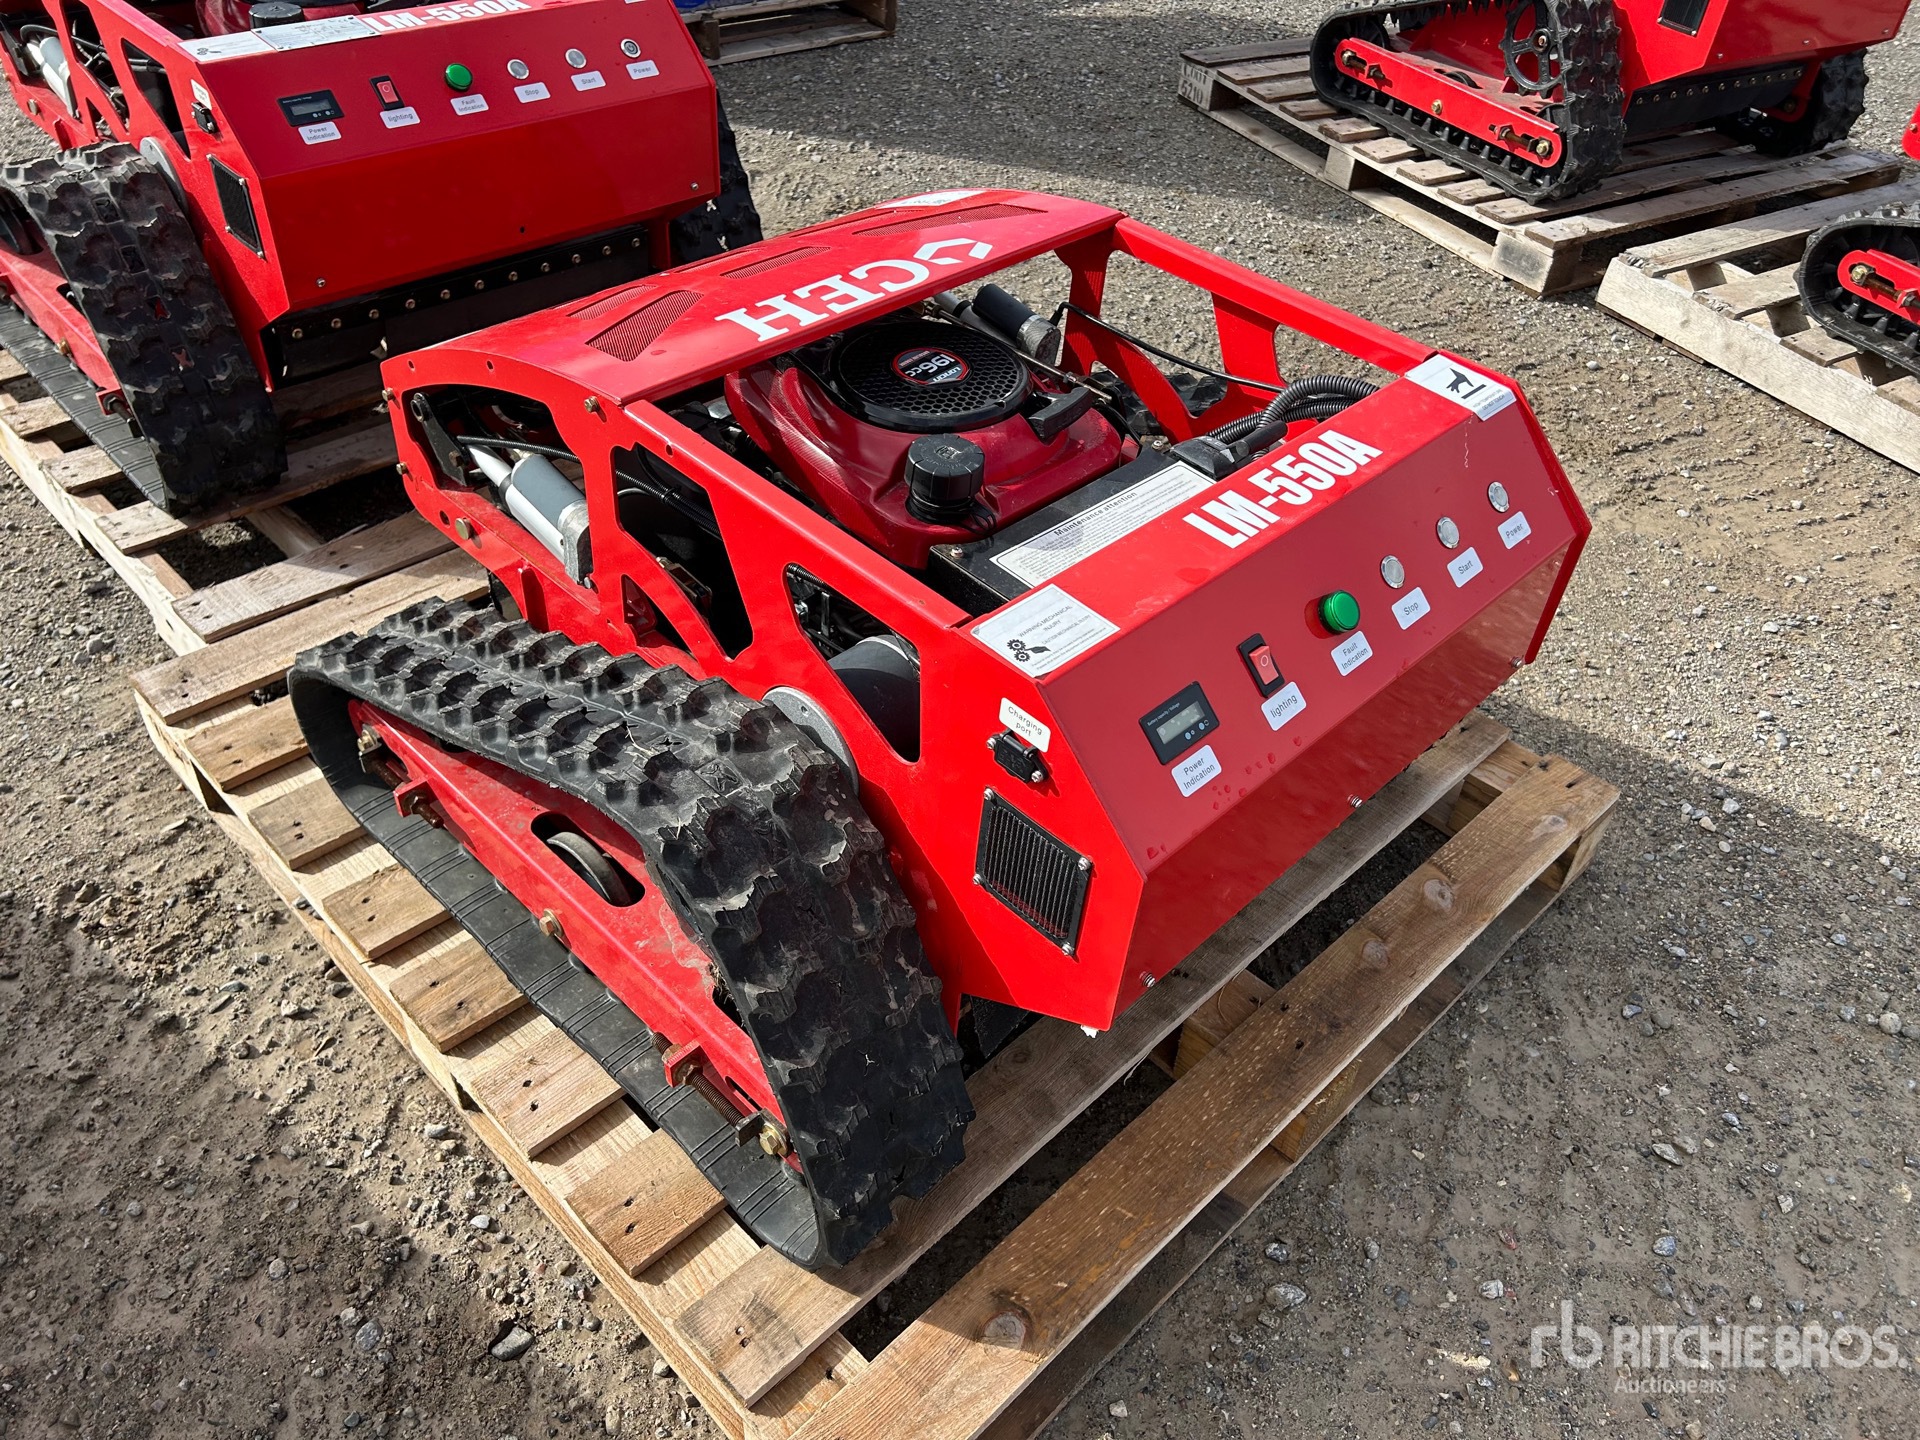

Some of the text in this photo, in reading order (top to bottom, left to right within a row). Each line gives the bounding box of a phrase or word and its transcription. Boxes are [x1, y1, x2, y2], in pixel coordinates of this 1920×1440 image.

[363, 0, 531, 31] LM-550A
[581, 76, 596, 85] Start
[524, 89, 540, 97] Stop
[388, 112, 413, 123] lighting
[905, 354, 956, 377] 196cc
[1181, 429, 1384, 549] LM-550A
[1053, 491, 1138, 537] Maintenance attention
[1505, 523, 1523, 539] Power
[1457, 560, 1473, 575] Start
[1403, 601, 1419, 616] Stop
[1342, 642, 1358, 656] Fault
[1341, 648, 1369, 670] Indication
[1270, 694, 1298, 718] lighting
[1008, 706, 1043, 736] Charging
[1015, 722, 1032, 736] port
[1183, 757, 1205, 775] Power
[1183, 764, 1215, 789] Indication
